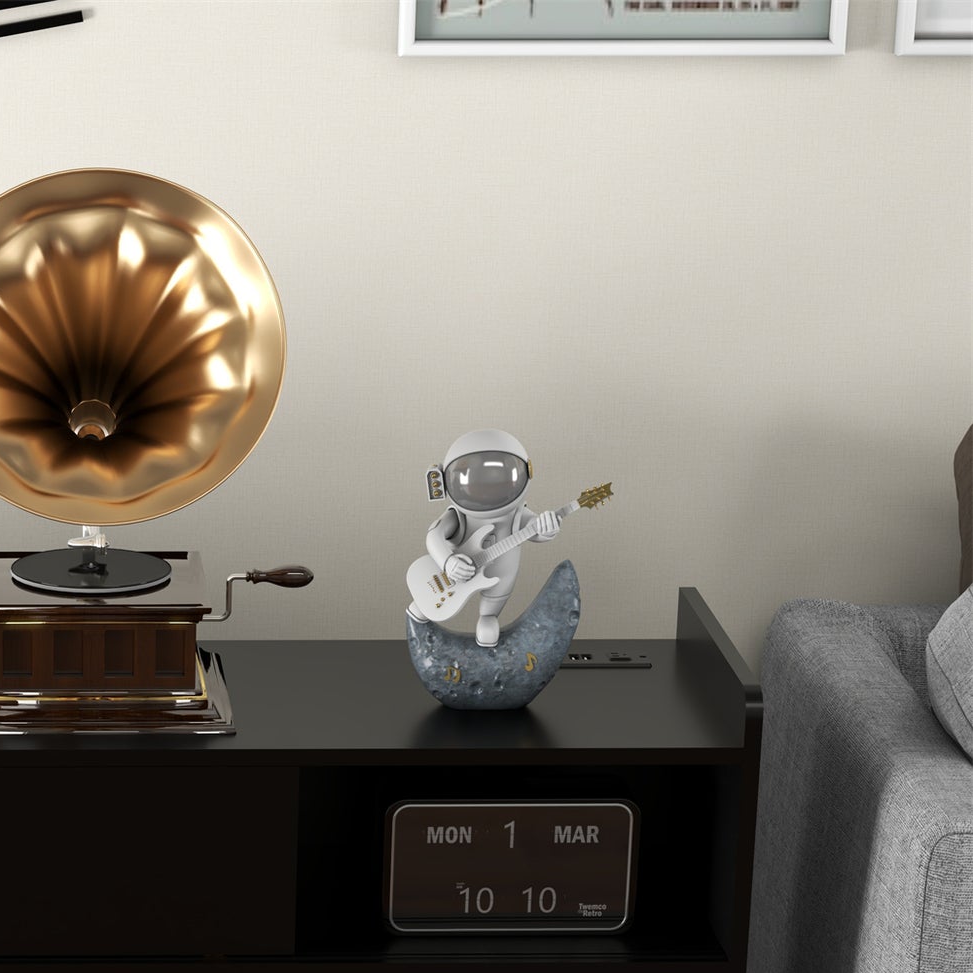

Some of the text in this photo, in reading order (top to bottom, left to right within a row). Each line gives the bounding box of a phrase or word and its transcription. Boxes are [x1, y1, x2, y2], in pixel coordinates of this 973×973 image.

[426, 826, 472, 844] MON
[503, 820, 516, 849] 1
[553, 825, 600, 844] MAR
[459, 887, 495, 914] 10
[522, 886, 557, 914] 10
[578, 902, 607, 911] Twemco
